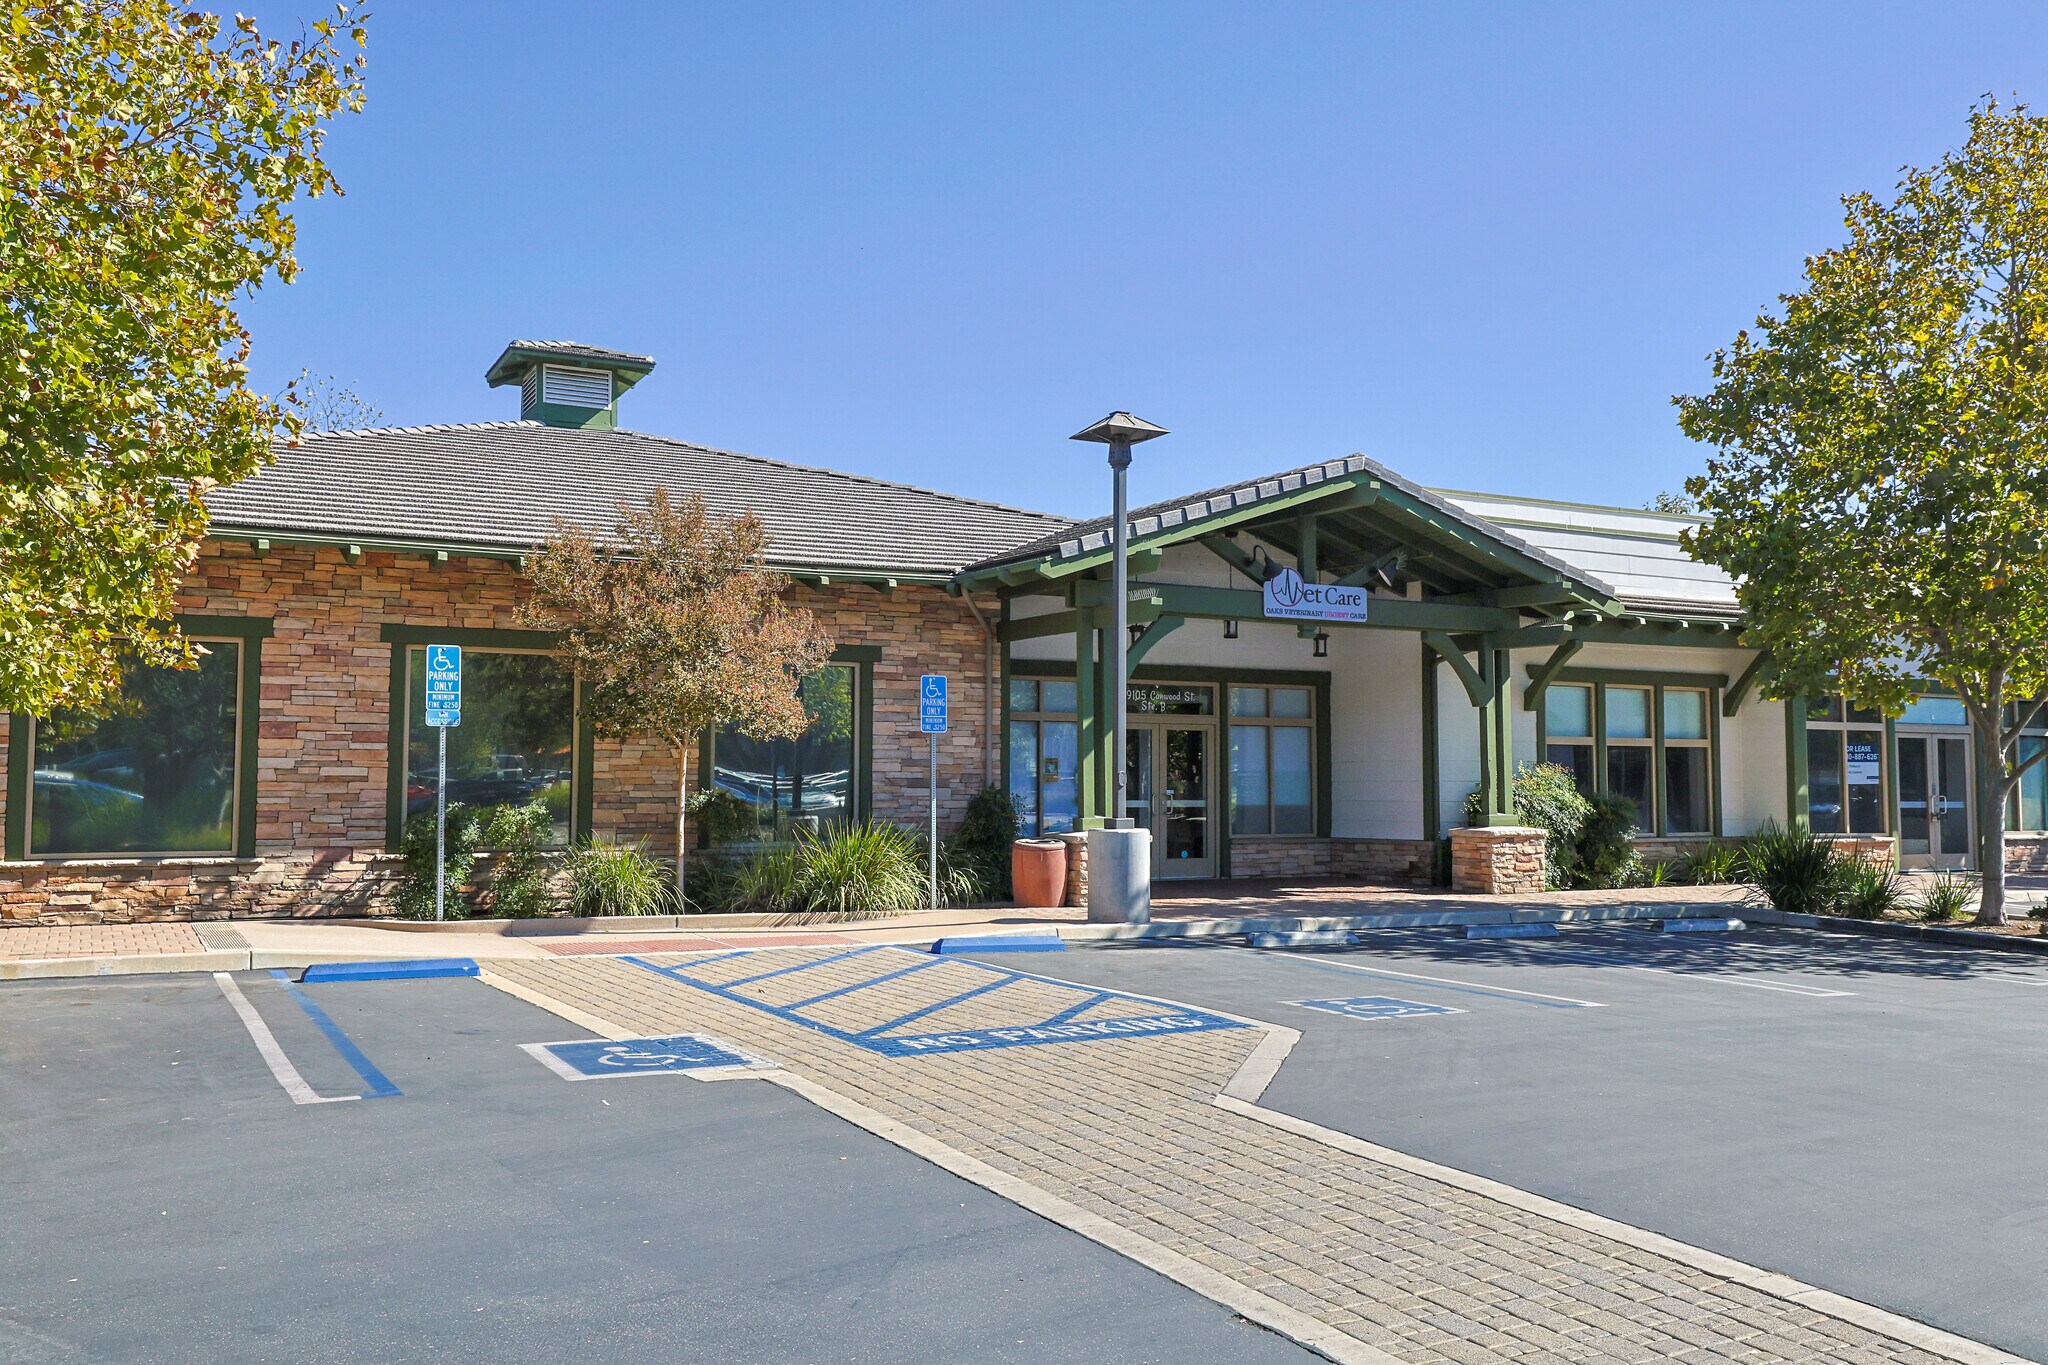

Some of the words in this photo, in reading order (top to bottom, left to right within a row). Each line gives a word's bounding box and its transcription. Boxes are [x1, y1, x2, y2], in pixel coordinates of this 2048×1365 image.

[1325, 587, 1361, 606] Care
[1284, 608, 1324, 617] VETERINARY
[429, 671, 458, 681] PARKING
[434, 682, 453, 691] ONLY
[1127, 690, 1146, 700] 9105
[1184, 691, 1195, 701] St.
[923, 698, 945, 706] PARKING
[1141, 700, 1158, 711] Ste.
[1160, 702, 1166, 711] B
[927, 707, 941, 715] ONLY
[897, 1034, 982, 1050] NO
[988, 1015, 1204, 1042] PARKING
